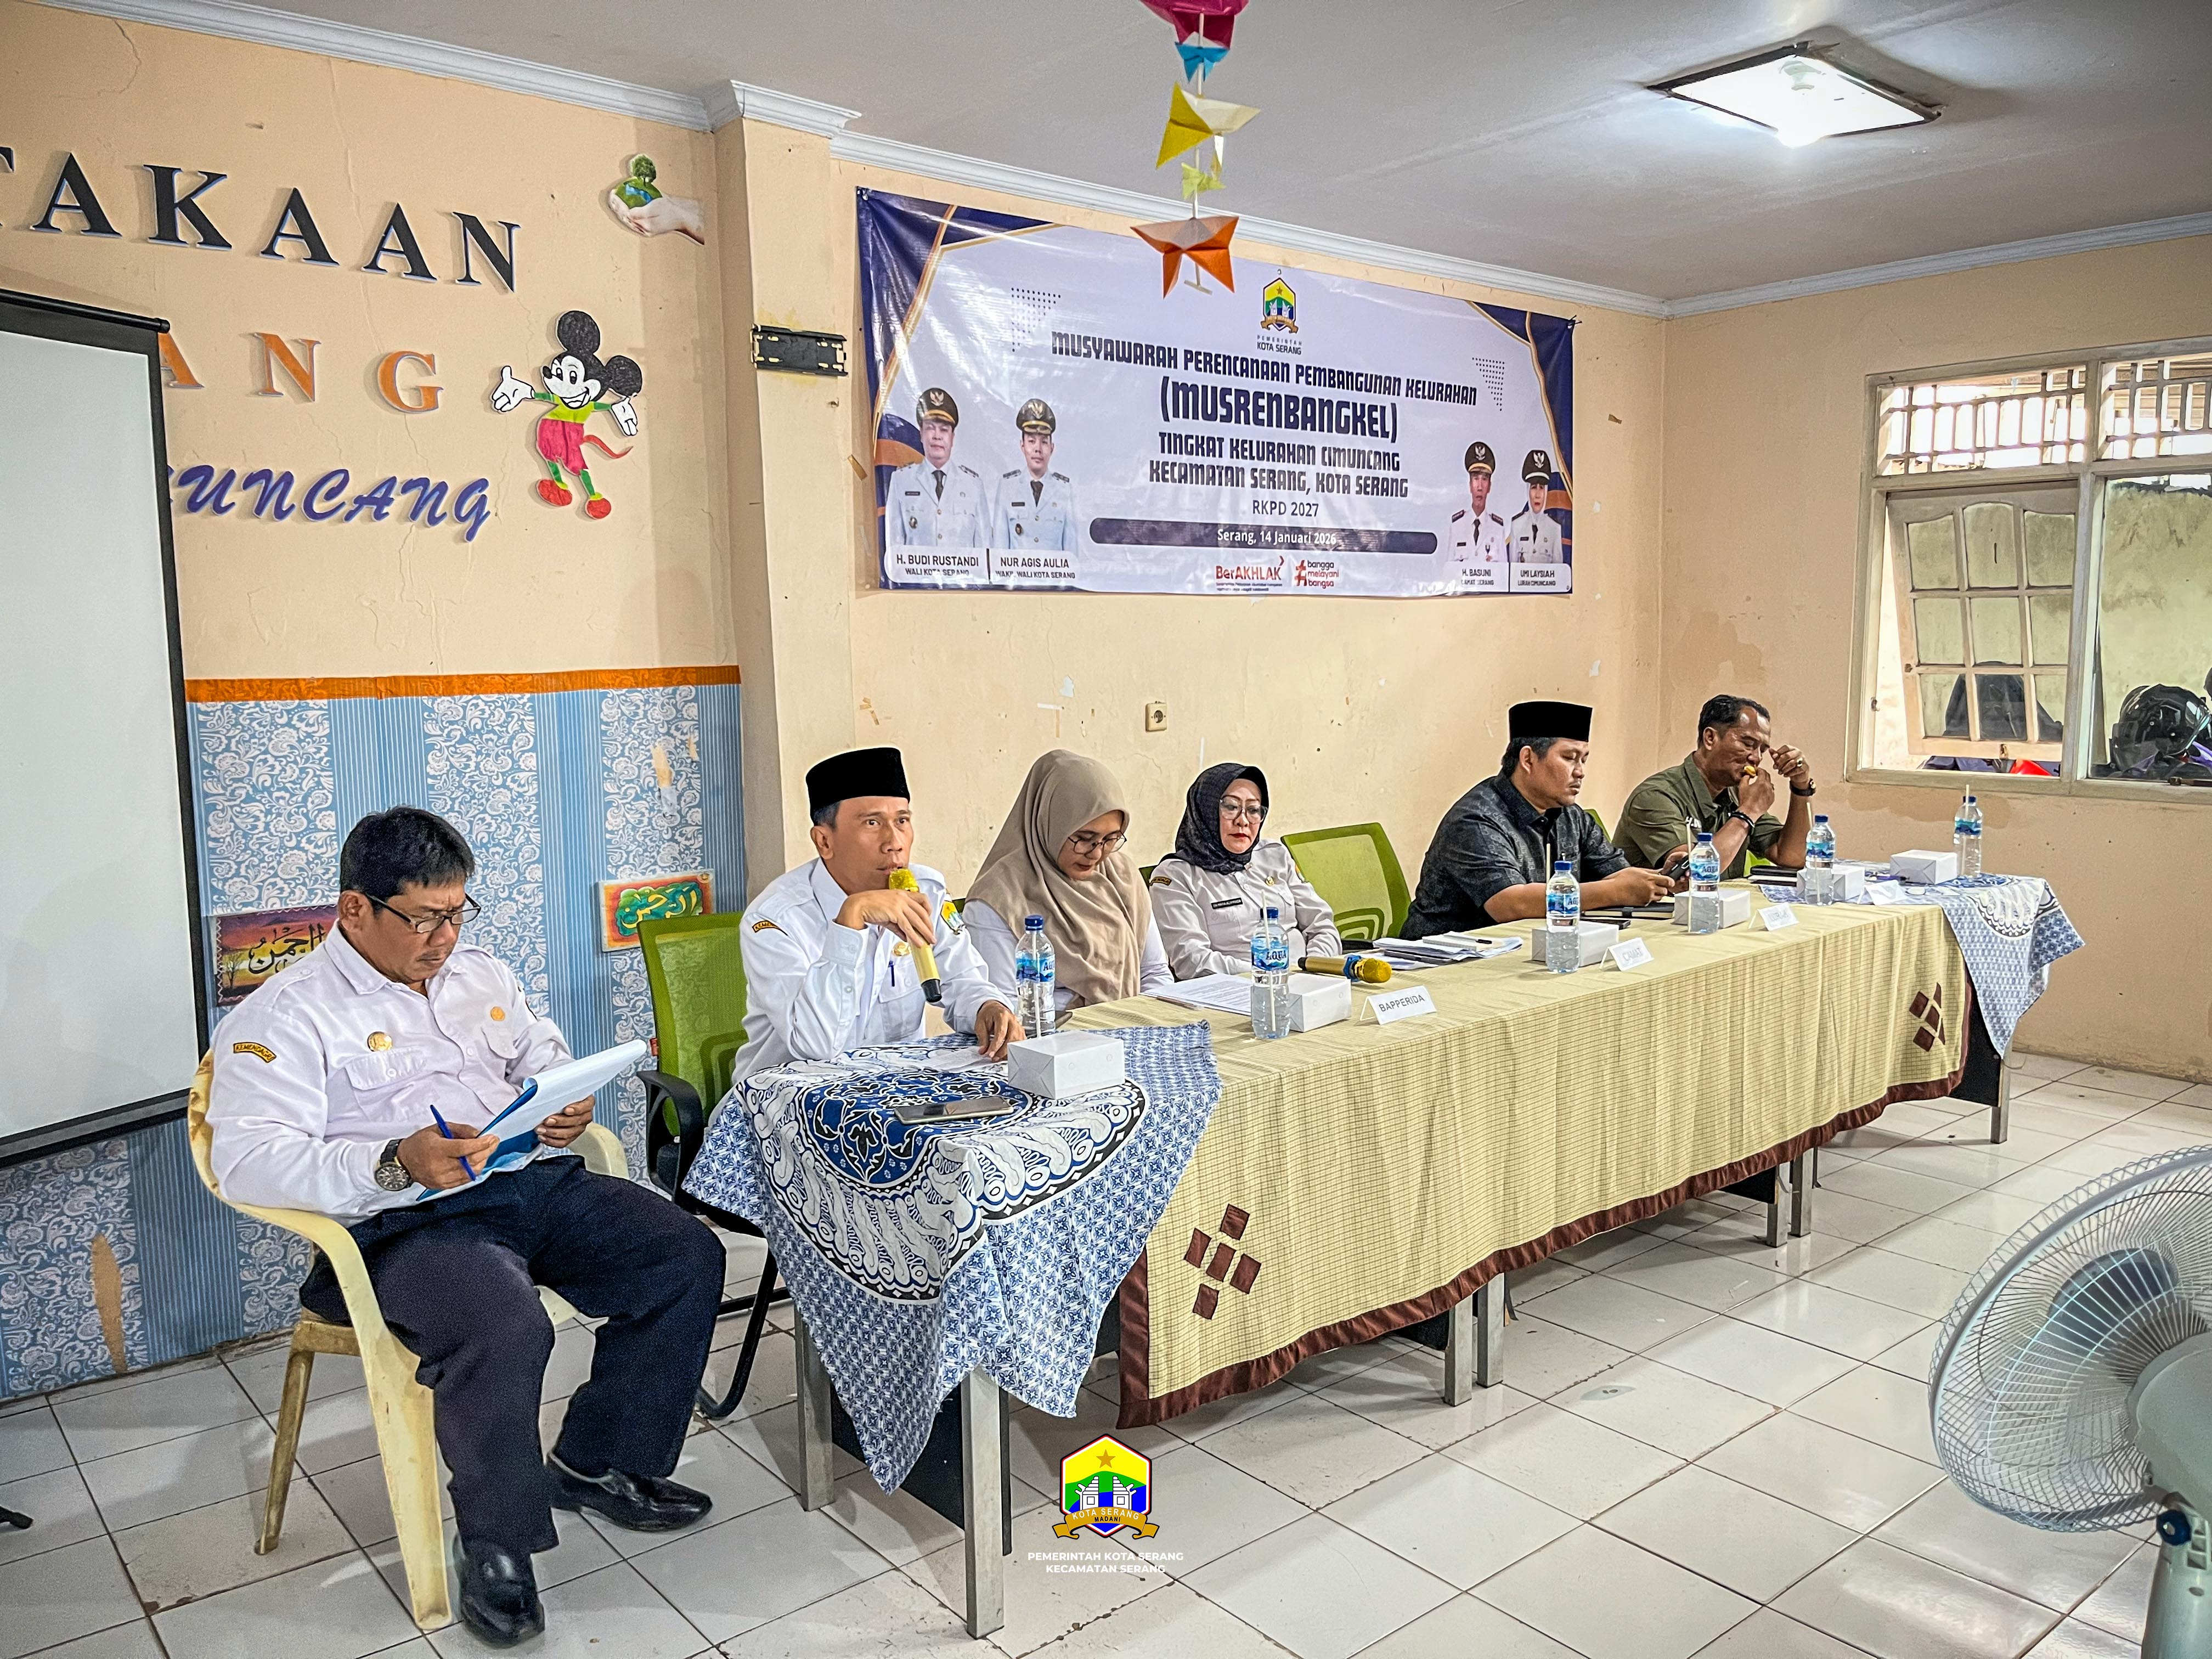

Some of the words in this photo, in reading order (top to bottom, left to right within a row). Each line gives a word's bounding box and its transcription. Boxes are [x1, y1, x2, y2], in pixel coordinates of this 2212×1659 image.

[0, 146, 520, 292] AKAAN
[1257, 342, 1273, 352] KOTA
[1276, 345, 1301, 355] SERANG
[1051, 331, 1178, 370] MUSYAWARAH
[1183, 349, 1290, 383] PERENCANAAN
[1295, 364, 1402, 397] PEMBANGUNAN
[1405, 378, 1477, 406] KELURAHAN
[1161, 376, 1397, 443] (MUSRENBANGKEL)
[1159, 432, 1224, 459] TINGKAT
[1229, 438, 1316, 466] KELURAHAN
[1321, 446, 1400, 472] CIMUNCANG
[1149, 460, 1245, 488] KECAMATAN
[1250, 467, 1311, 495] SERANG,
[1316, 472, 1351, 494] KOTA
[1355, 476, 1408, 498] SERANG
[167, 464, 490, 543] UNCANG
[1252, 499, 1287, 516] RKPD
[1290, 501, 1319, 517] 2027
[1217, 528, 1257, 545] Serang,
[1259, 531, 1271, 543] 14
[1272, 532, 1312, 545] Januari
[1313, 533, 1337, 545] 2026
[896, 554, 906, 565] H.
[908, 555, 930, 566] BUDI
[933, 555, 979, 567] RUSTANDI
[1000, 557, 1019, 567] NUR
[1021, 558, 1041, 568] AGIS
[1043, 558, 1069, 568] AULIA
[1307, 560, 1334, 571] bangga
[1215, 565, 1282, 580] BerAKHLAK
[1307, 569, 1339, 579] melayani
[1308, 579, 1334, 589] bangsa
[1266, 950, 1286, 961] AQUA
[1378, 994, 1425, 1012] BAPPERIDA
